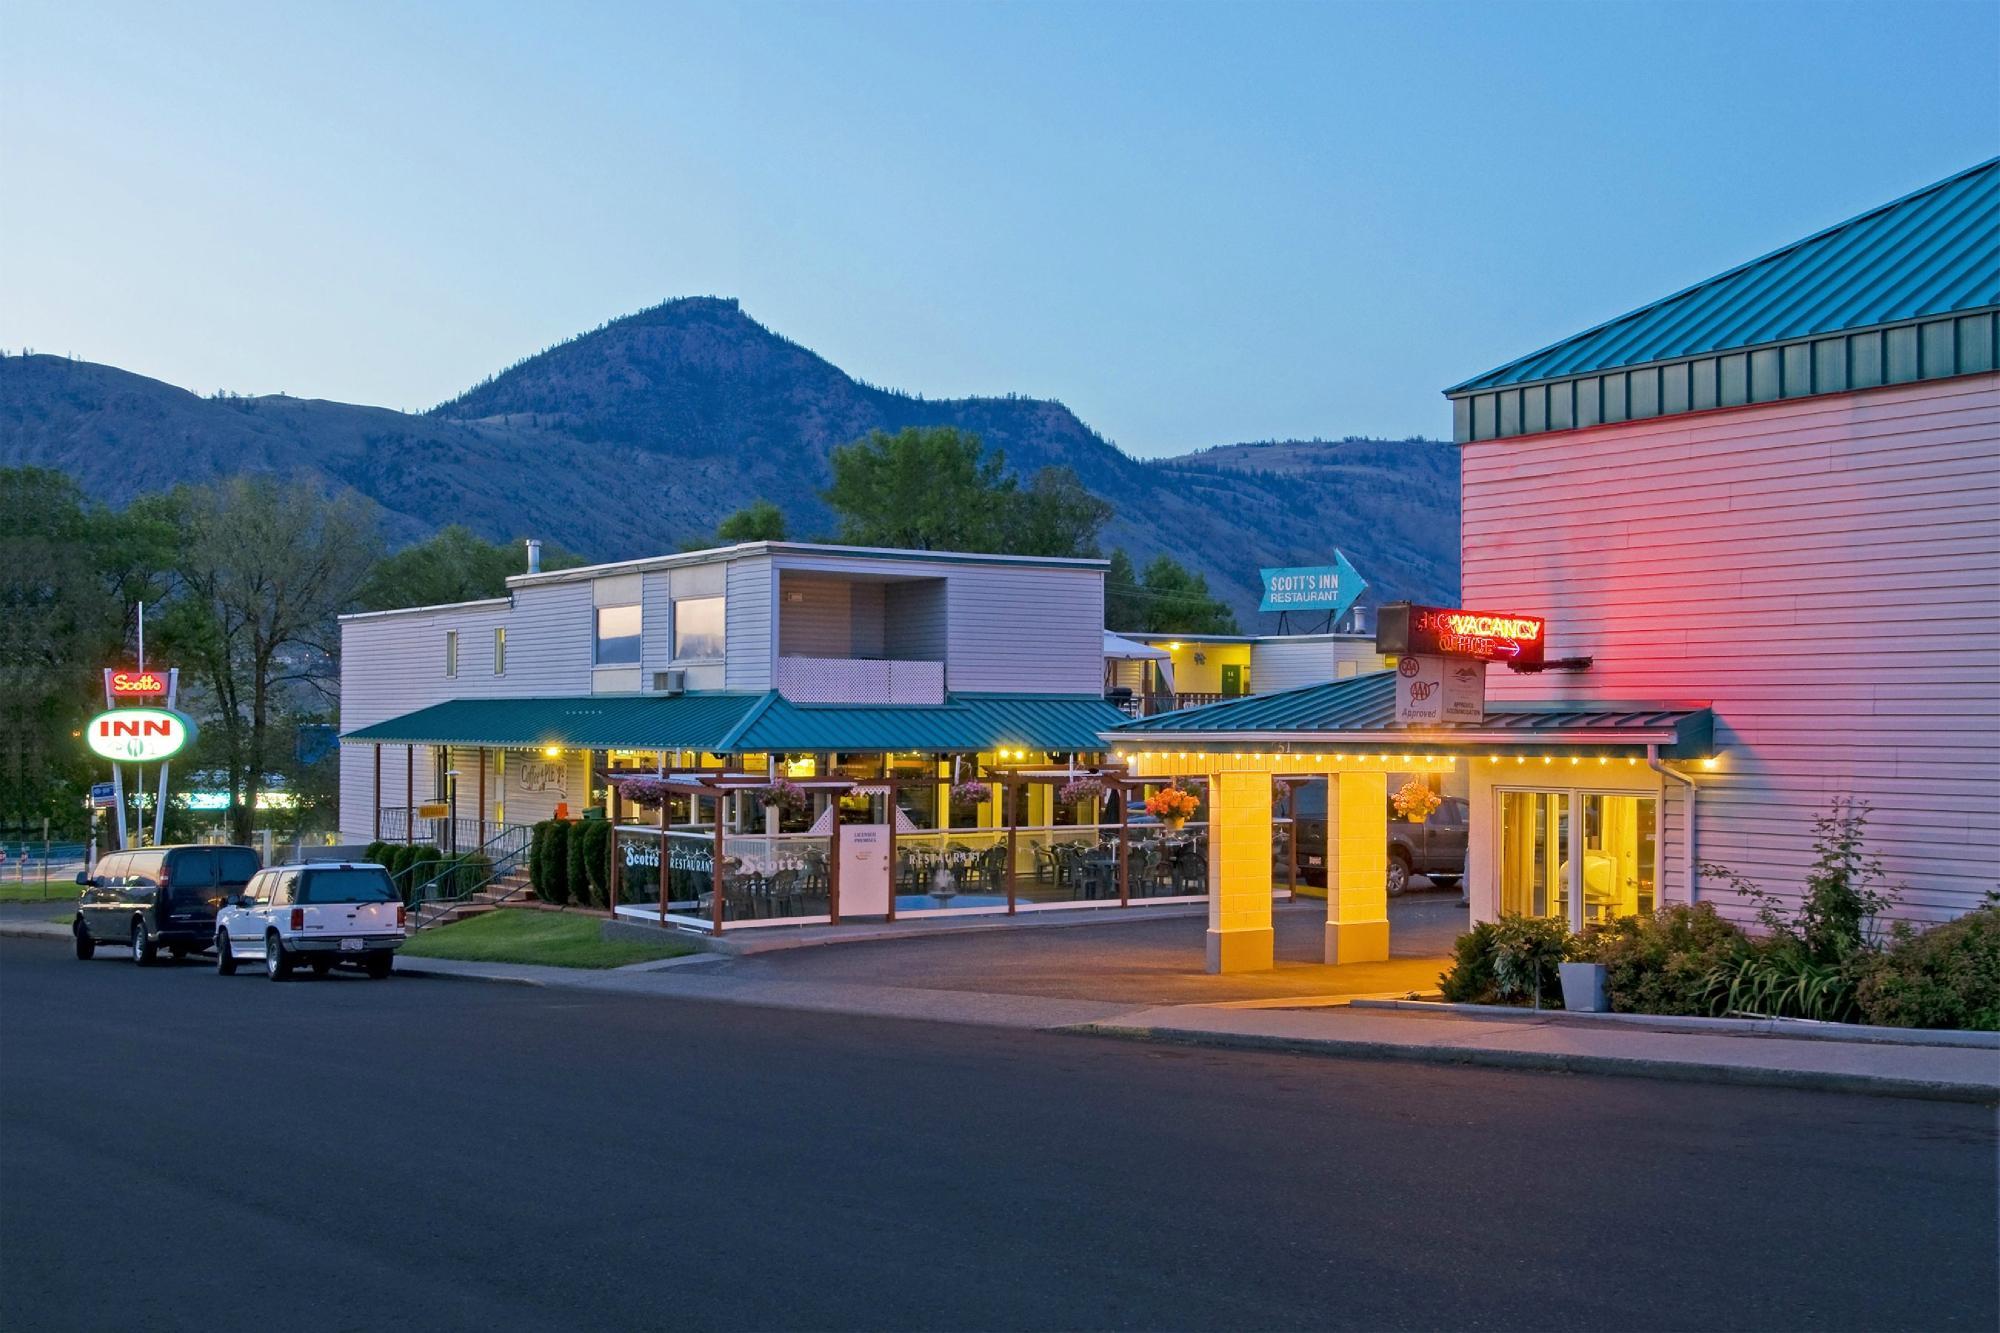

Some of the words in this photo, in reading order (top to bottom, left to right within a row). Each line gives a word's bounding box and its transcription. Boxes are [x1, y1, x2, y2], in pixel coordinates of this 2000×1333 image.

[1271, 575, 1315, 591] SCOTT'S
[1320, 575, 1338, 589] INN
[1270, 591, 1338, 603] RESTAURANT
[1450, 614, 1540, 640] VACANCY
[114, 674, 161, 691] Scotts
[1411, 682, 1430, 699] AAA
[1402, 708, 1437, 719] Approved
[100, 719, 171, 737] INN
[625, 846, 660, 867] Scott's
[669, 857, 713, 873] RESTAURANT
